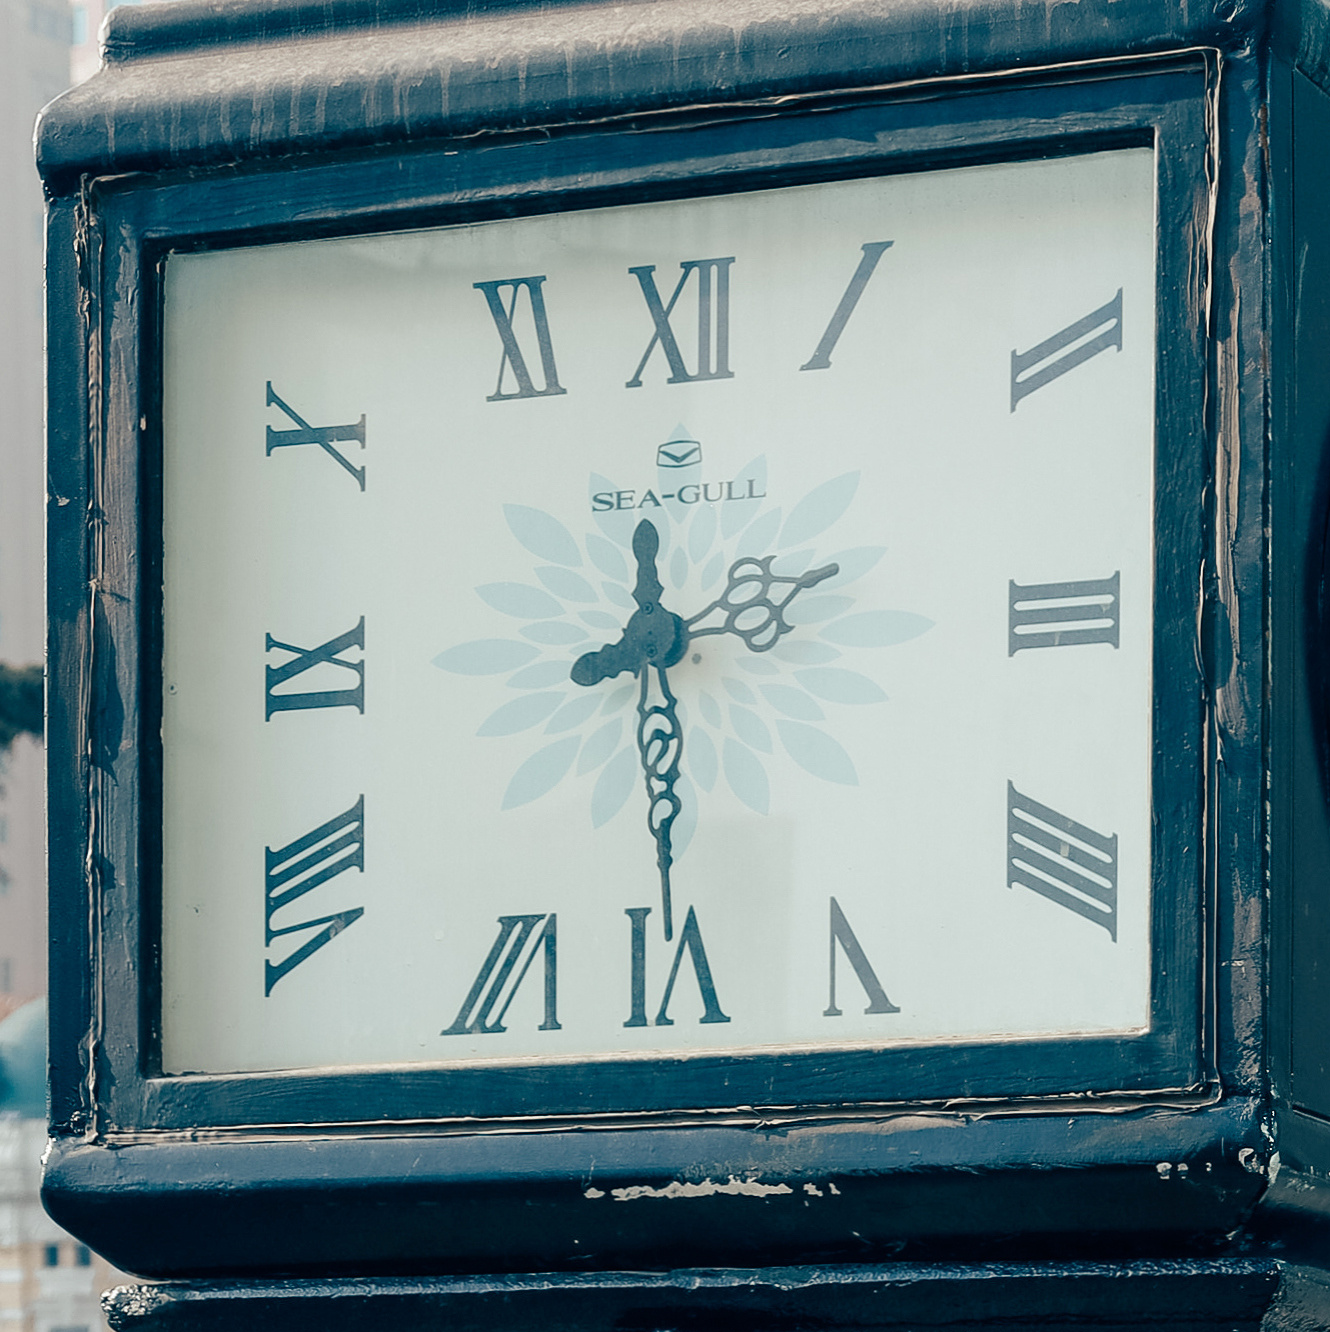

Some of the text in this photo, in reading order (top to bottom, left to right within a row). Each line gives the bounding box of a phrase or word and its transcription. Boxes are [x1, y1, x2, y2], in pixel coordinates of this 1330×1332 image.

[472, 275, 567, 402] XI
[625, 256, 736, 388] XII
[1011, 287, 1123, 413] II
[266, 381, 366, 492] X
[592, 479, 766, 512] SEA-GULL
[265, 616, 365, 722] IX
[1008, 570, 1120, 657] III
[264, 794, 364, 998] VIII
[1007, 779, 1118, 943] IIII
[440, 913, 562, 1036] VII
[623, 905, 731, 1028] VI
[823, 897, 901, 1016] V
